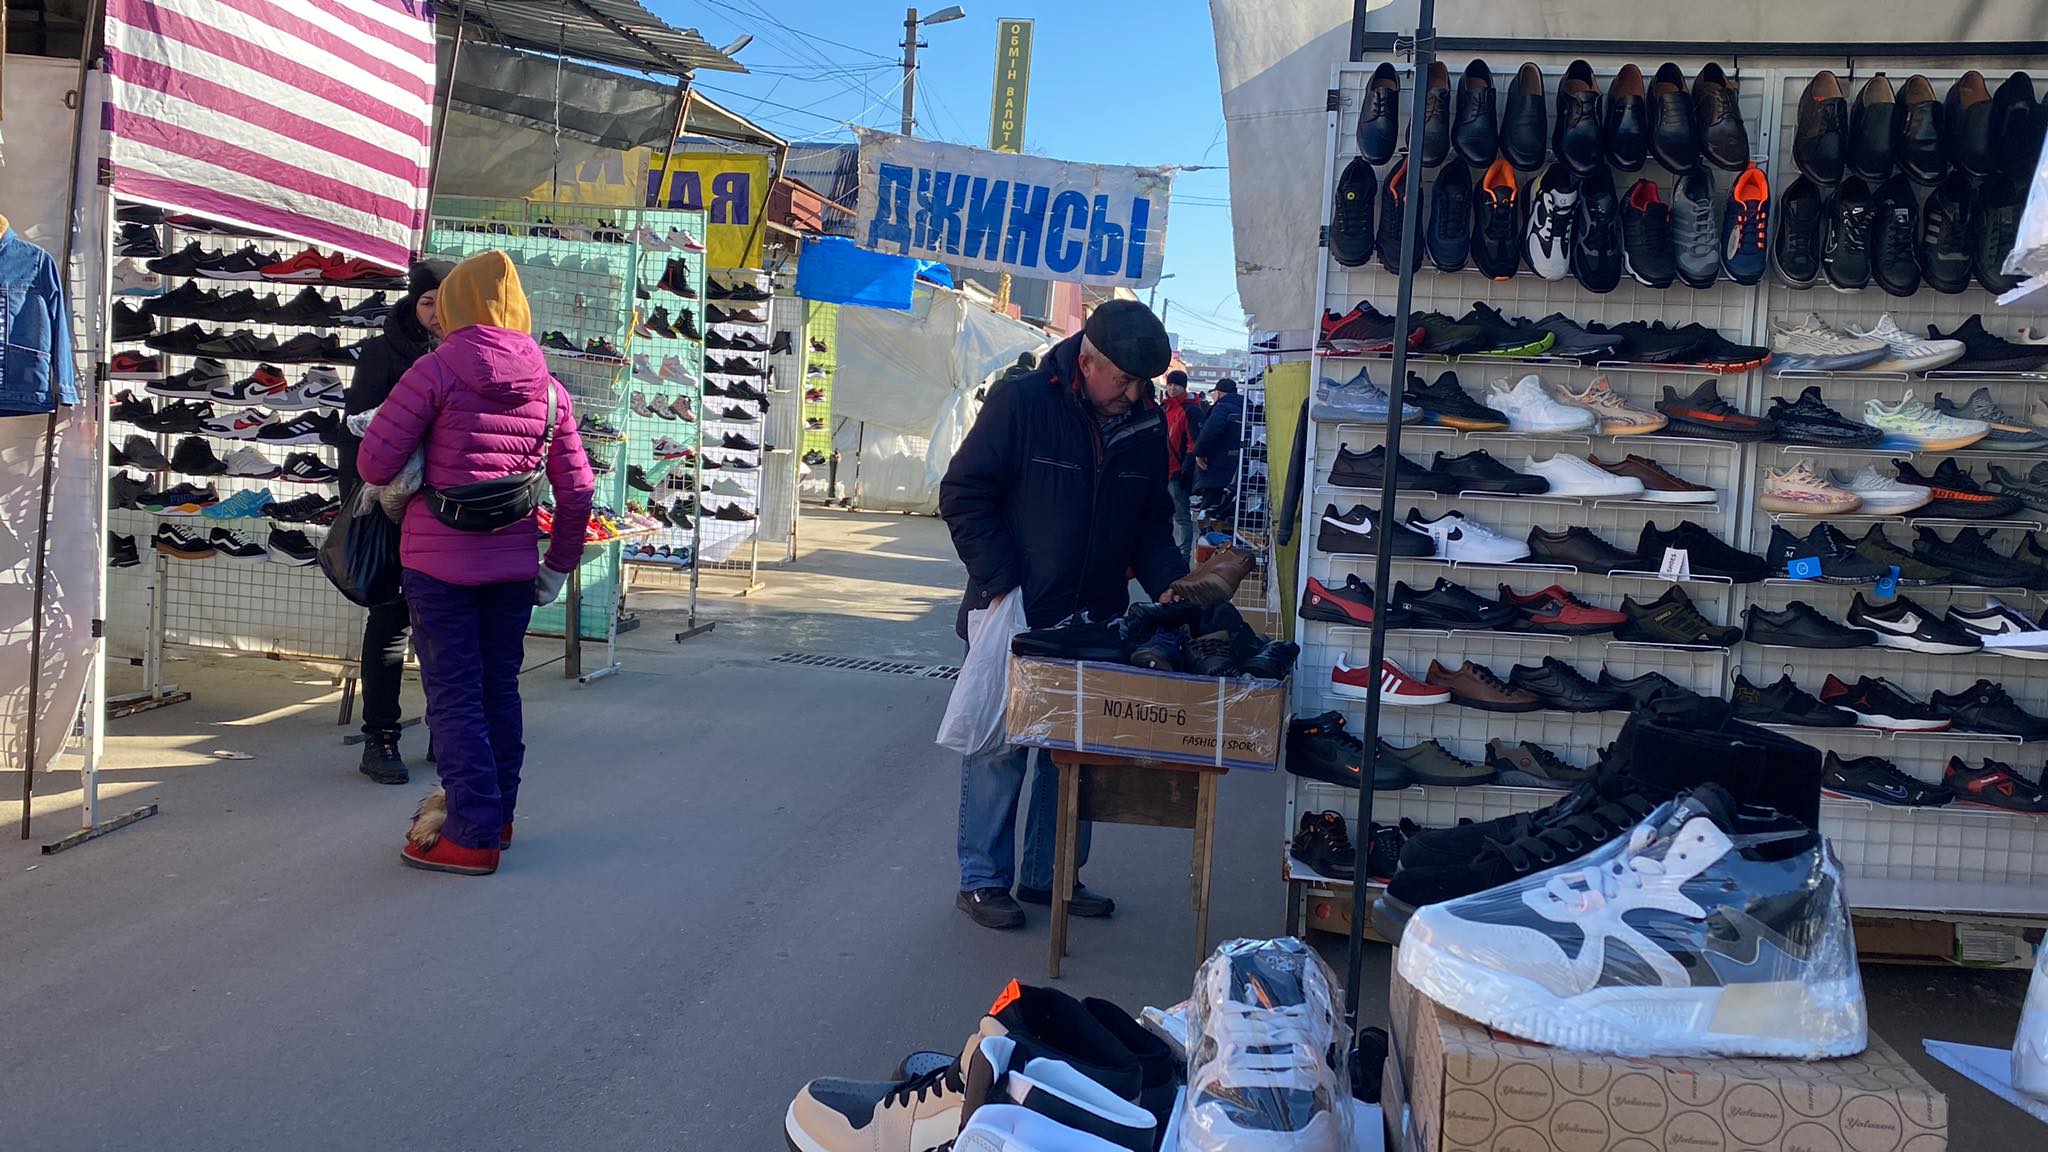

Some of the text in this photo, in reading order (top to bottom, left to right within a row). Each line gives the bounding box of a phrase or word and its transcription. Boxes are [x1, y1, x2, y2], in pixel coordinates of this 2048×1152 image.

[1000, 24, 1021, 142] ОБМІН ВАЛЮТ
[868, 162, 1151, 279] ДЖИНСЫ
